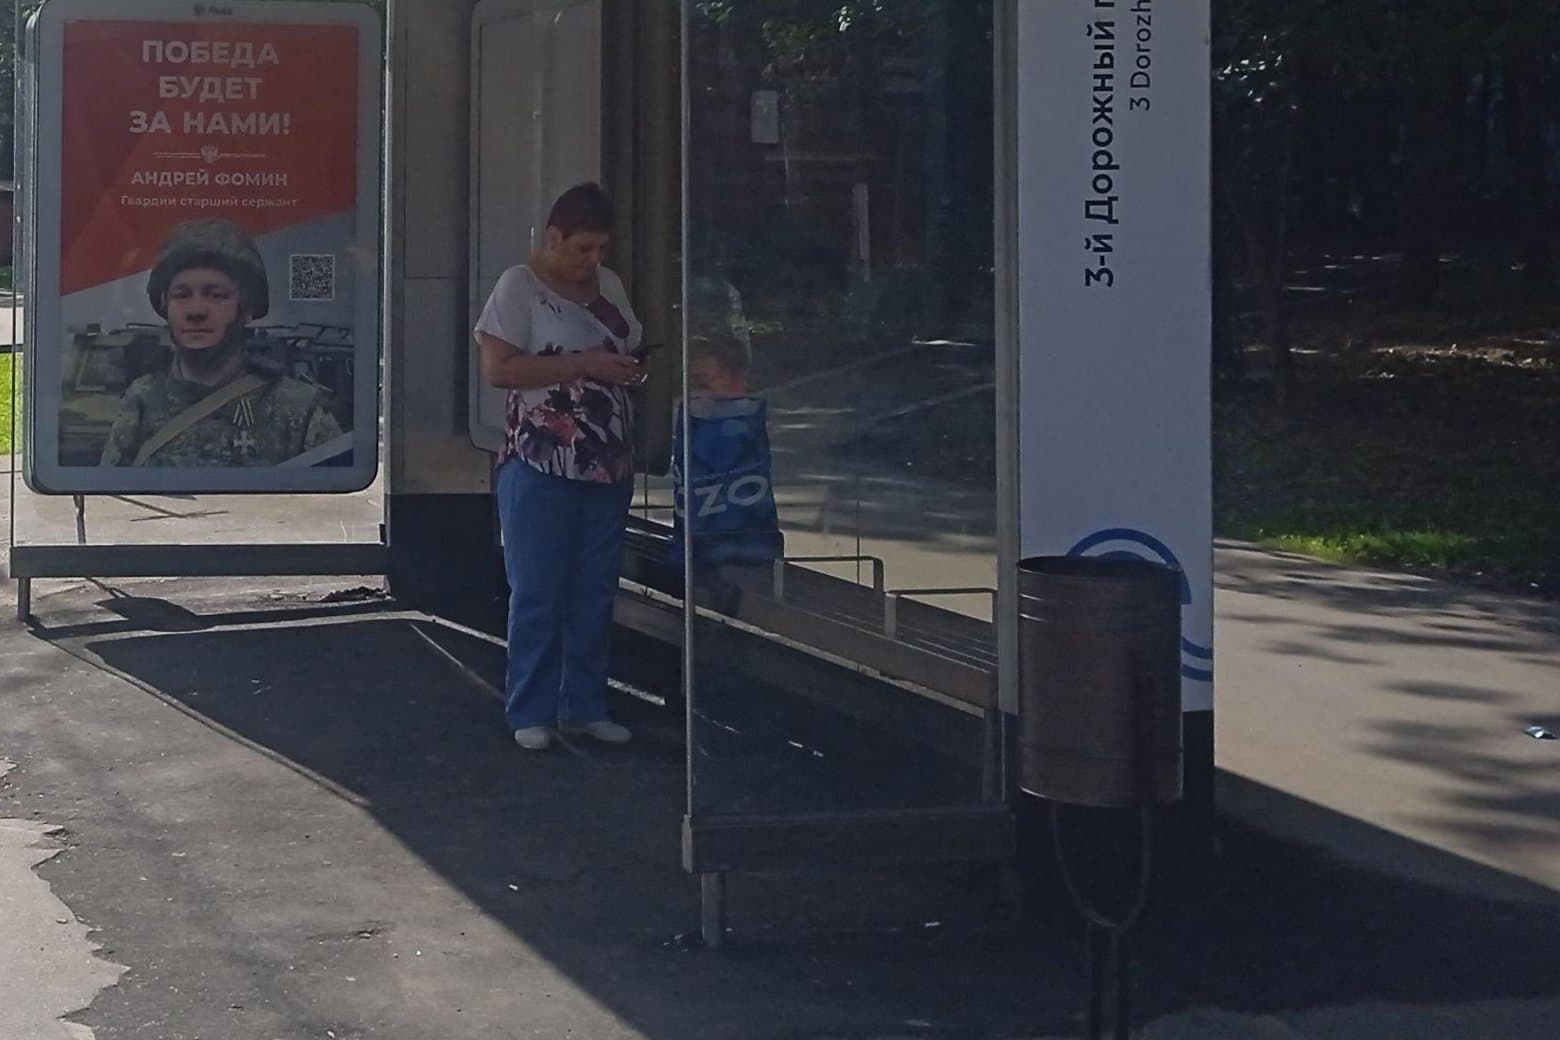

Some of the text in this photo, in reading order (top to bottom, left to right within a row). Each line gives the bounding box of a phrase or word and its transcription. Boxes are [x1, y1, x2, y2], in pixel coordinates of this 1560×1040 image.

[141, 39, 280, 69] ПОБЕДА
[158, 75, 264, 103] БУДЕТ
[1130, 97, 1150, 112] 3
[129, 110, 291, 136] ЗА НАМИ!
[1085, 22, 1120, 225] Дорожный
[131, 169, 288, 188] АНДРЕЙ ФОМИН
[120, 195, 297, 209] Гвардии старший сержант
[1085, 232, 1114, 288] 3-й
